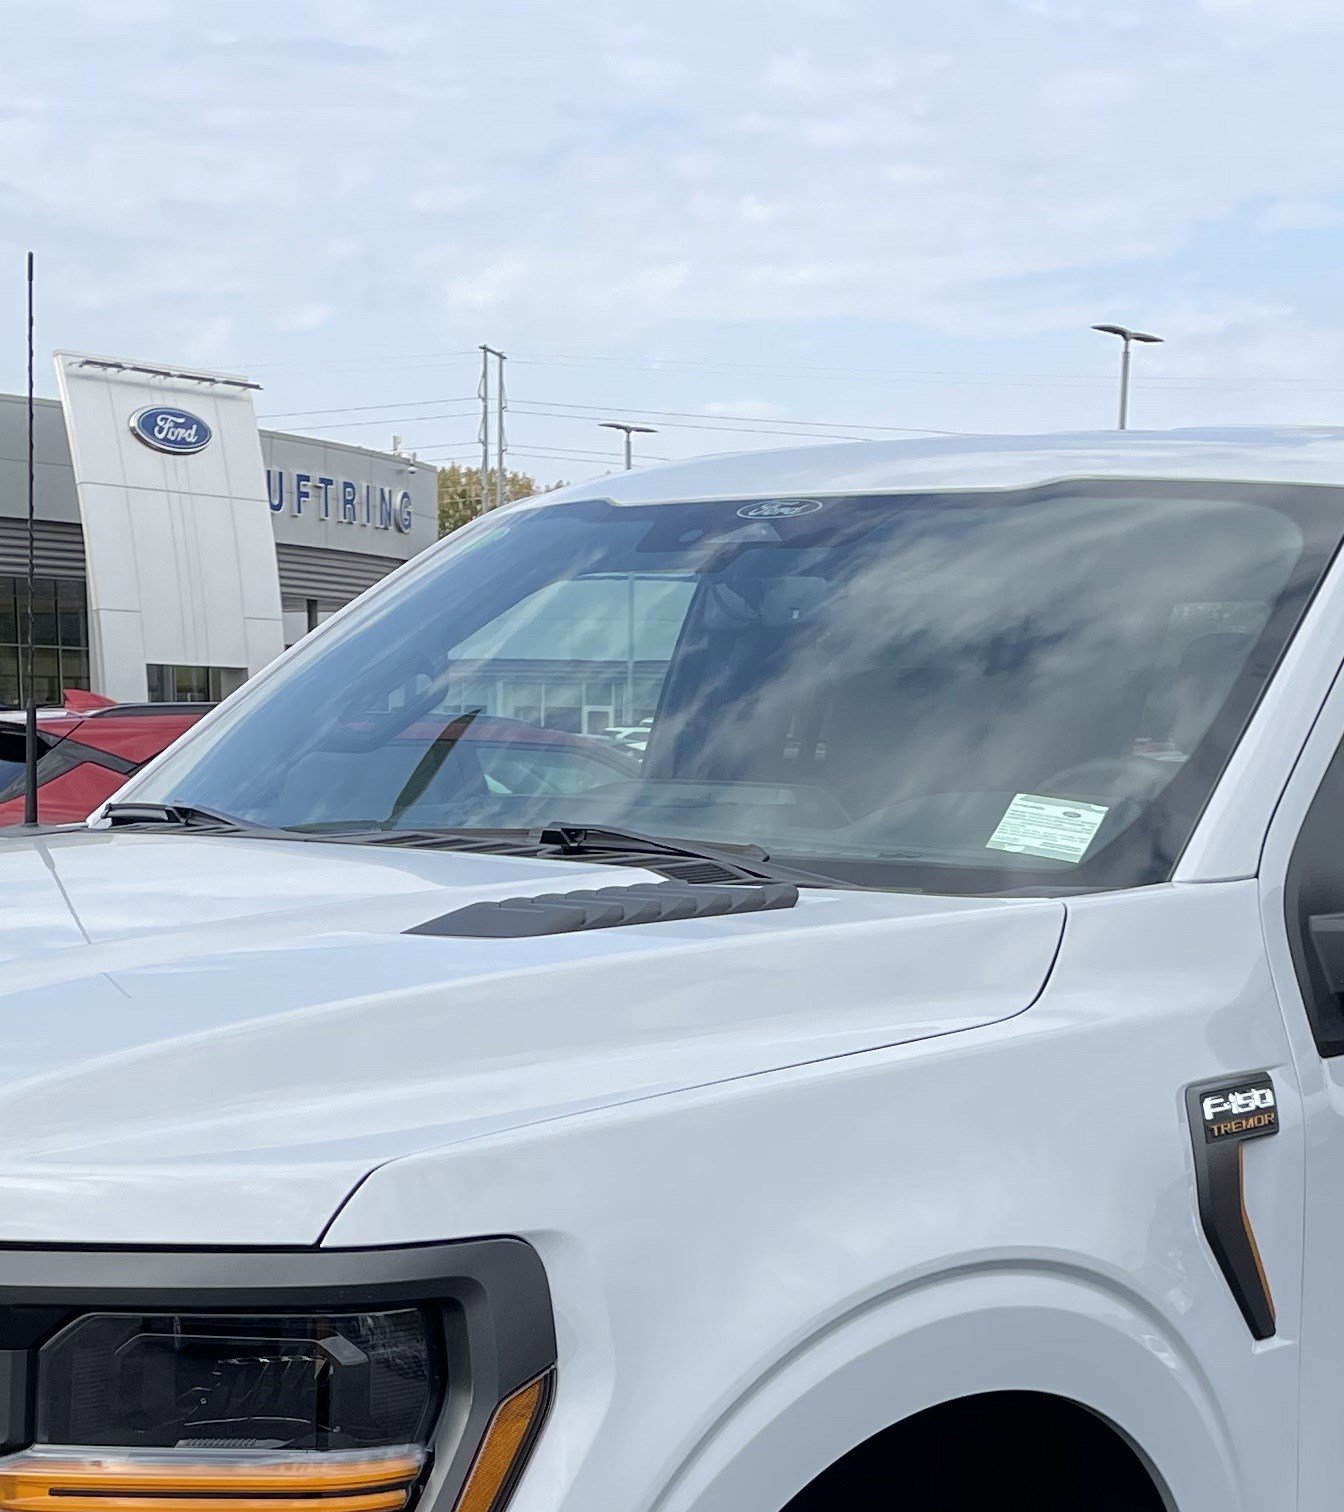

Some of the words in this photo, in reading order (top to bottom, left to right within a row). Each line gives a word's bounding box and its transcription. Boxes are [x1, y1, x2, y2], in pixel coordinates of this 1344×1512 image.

[154, 414, 198, 443] Ford
[266, 468, 413, 534] UFTRING
[747, 500, 810, 516] Ford
[1211, 1112, 1275, 1137] TREMOR
